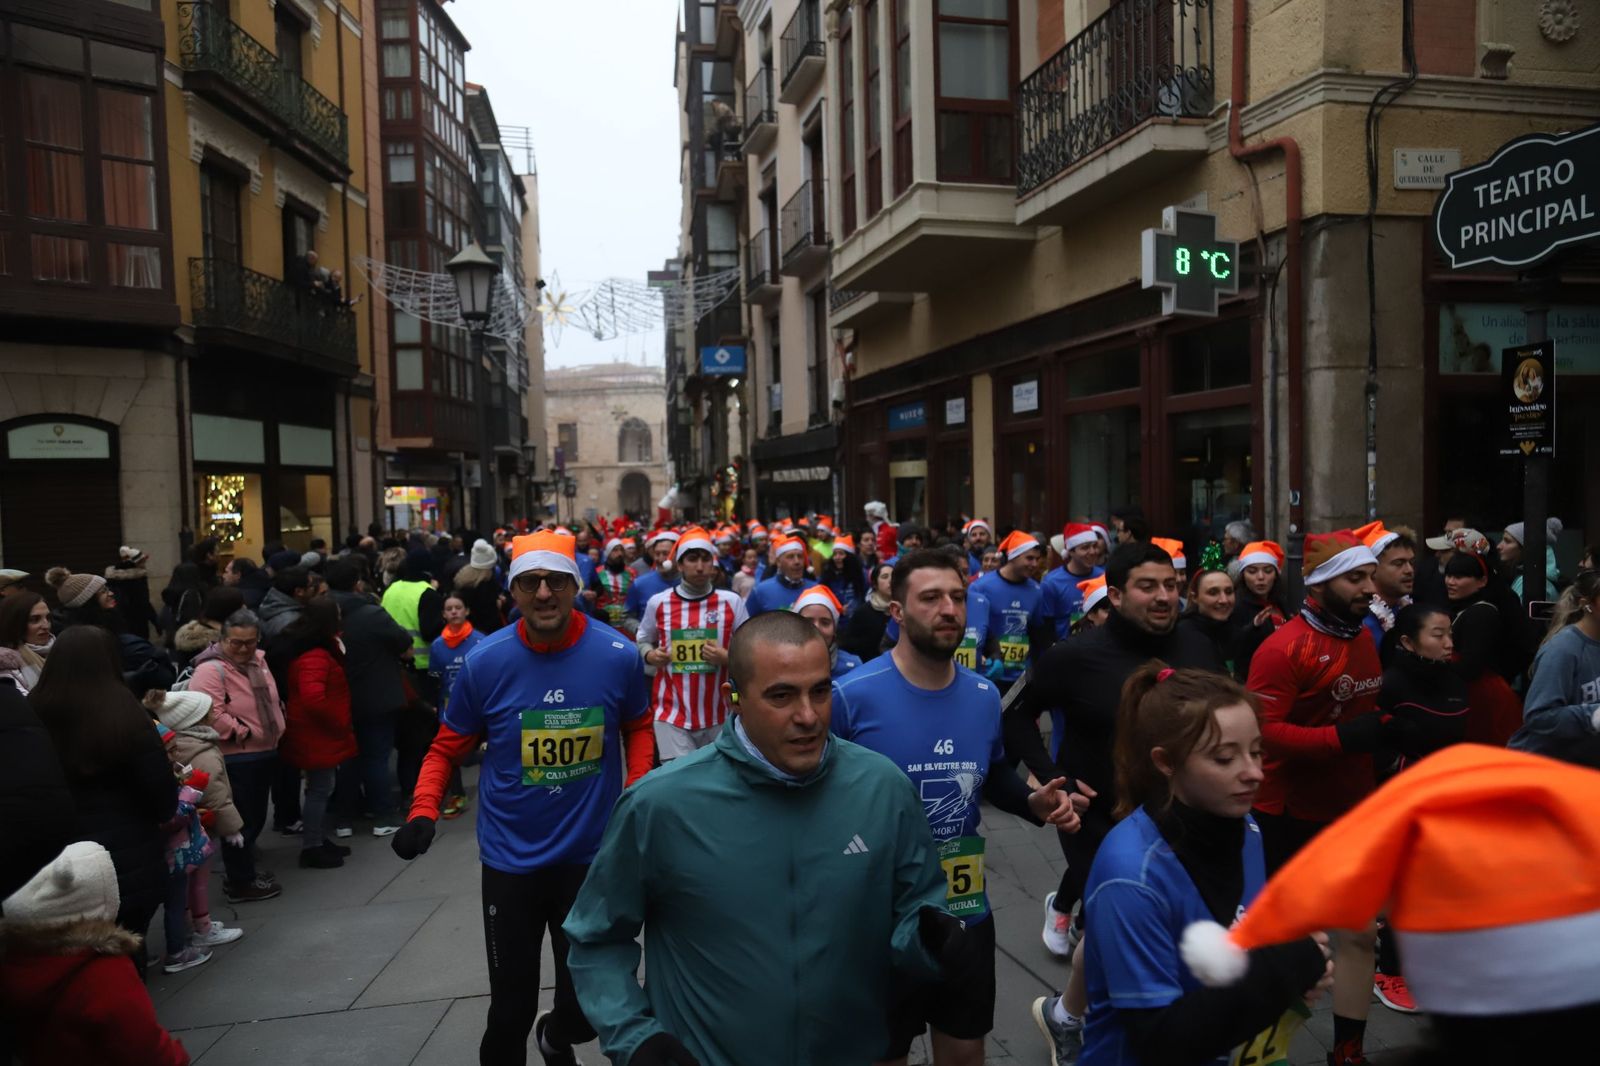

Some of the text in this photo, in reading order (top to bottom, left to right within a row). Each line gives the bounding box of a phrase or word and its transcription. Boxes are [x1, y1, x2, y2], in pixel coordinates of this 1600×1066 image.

[1417, 154, 1445, 163] CALLE
[1423, 165, 1435, 173] DE
[1473, 158, 1575, 208] TEATRO
[1460, 194, 1595, 249] PRINCIPAL
[1175, 247, 1191, 275] 8
[1481, 314, 1600, 328] Un aliad la salu
[1001, 645, 1024, 660] 754
[543, 688, 565, 704] 46
[528, 735, 592, 766] 1307
[933, 738, 954, 755] 46
[569, 763, 598, 777] RURAL
[907, 764, 922, 773] SAN
[924, 762, 960, 771] SILVESTRE
[932, 825, 957, 835] MORA
[944, 864, 971, 894] 5
[948, 899, 980, 912] RURAL
